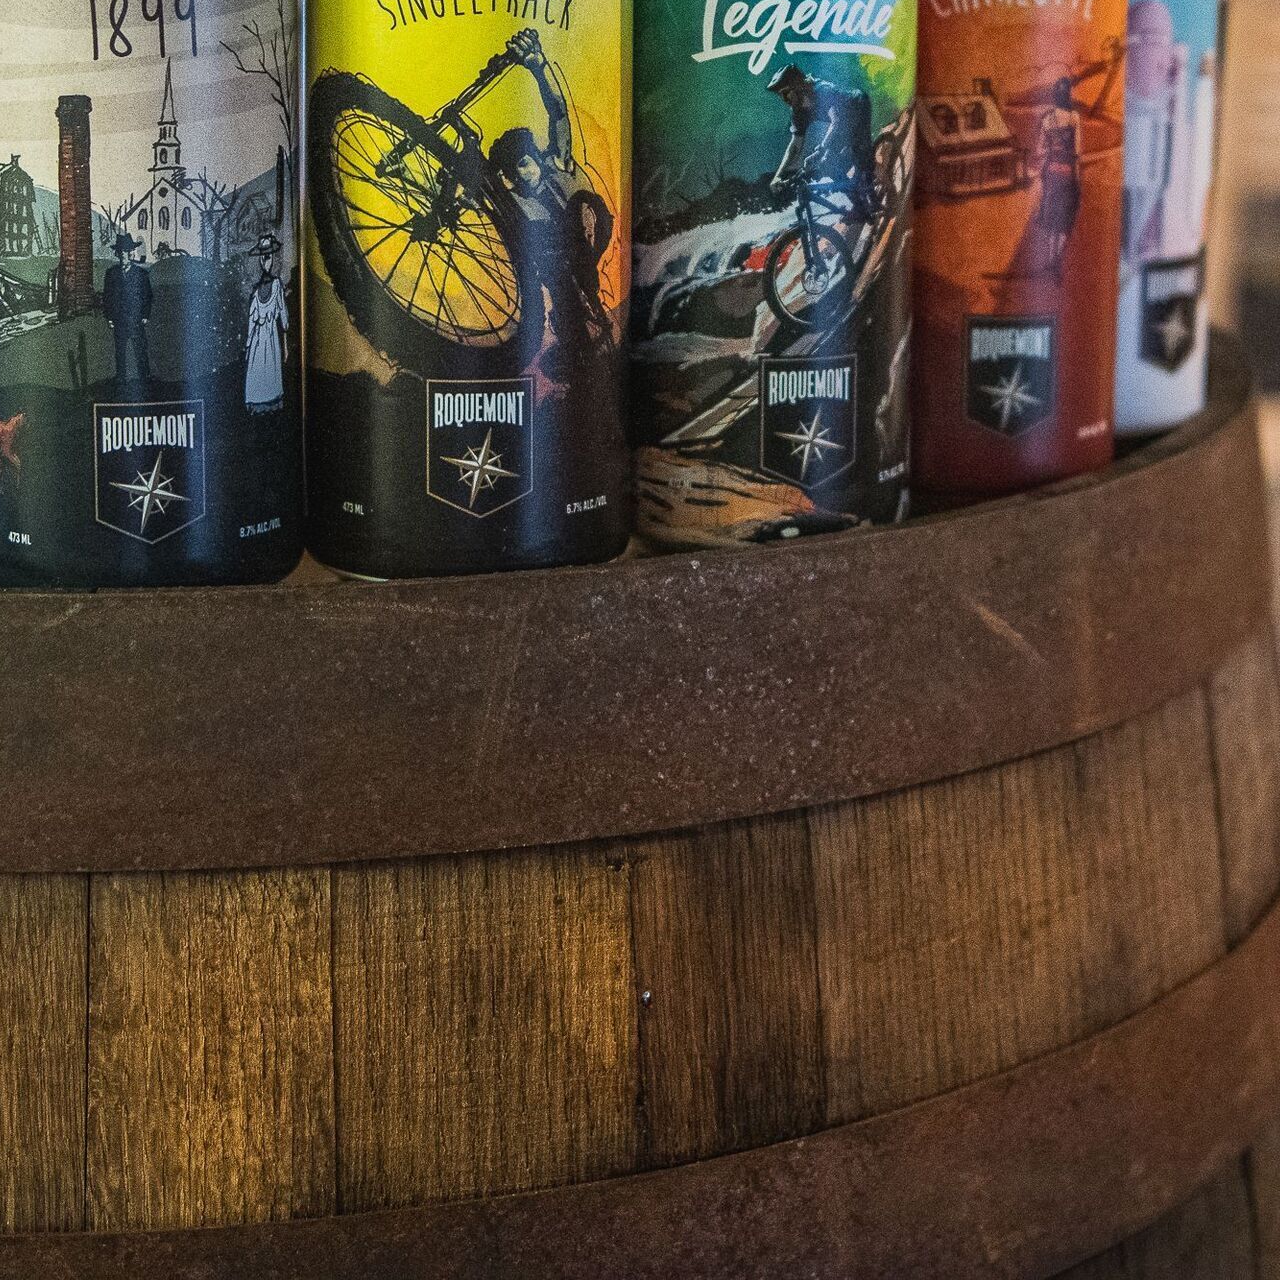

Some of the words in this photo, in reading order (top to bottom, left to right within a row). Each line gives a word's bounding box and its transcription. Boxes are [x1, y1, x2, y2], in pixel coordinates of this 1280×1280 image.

[768, 366, 851, 406] ROQUEMONT
[433, 391, 525, 428] ROQUEMONT
[101, 413, 196, 453] ROQUEMONT
[8, 530, 21, 544] 473
[21, 533, 32, 546] ML
